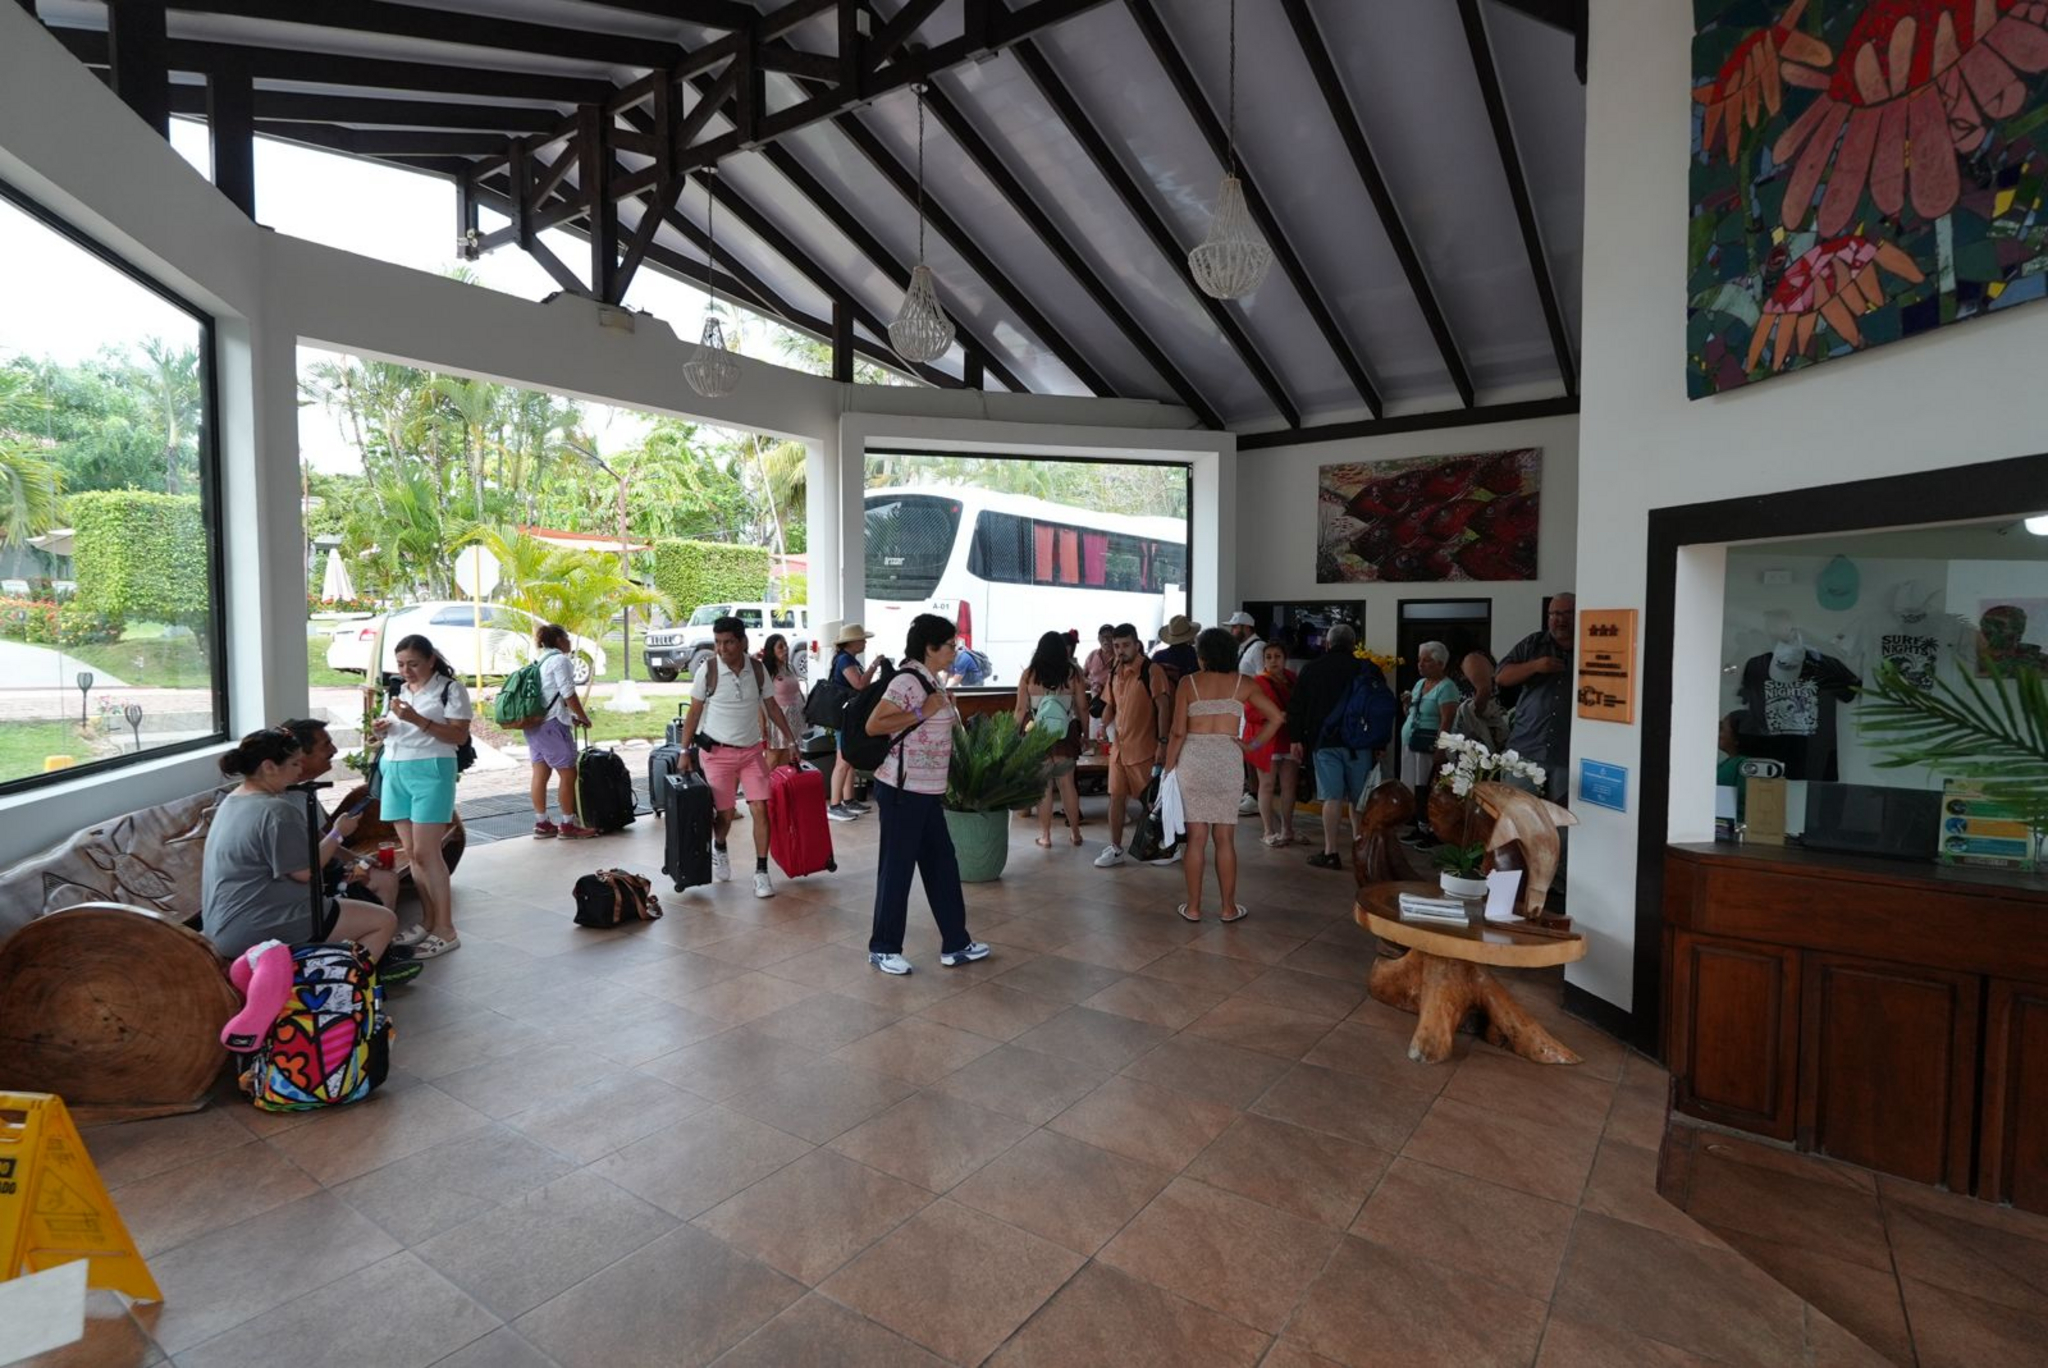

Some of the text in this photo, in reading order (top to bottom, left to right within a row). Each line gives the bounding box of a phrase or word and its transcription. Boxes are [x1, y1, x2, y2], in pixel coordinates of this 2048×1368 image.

[1882, 635, 1923, 645] SURF
[1882, 645, 1929, 655] NIGHTS
[1764, 688, 1809, 699] NIGHTS
